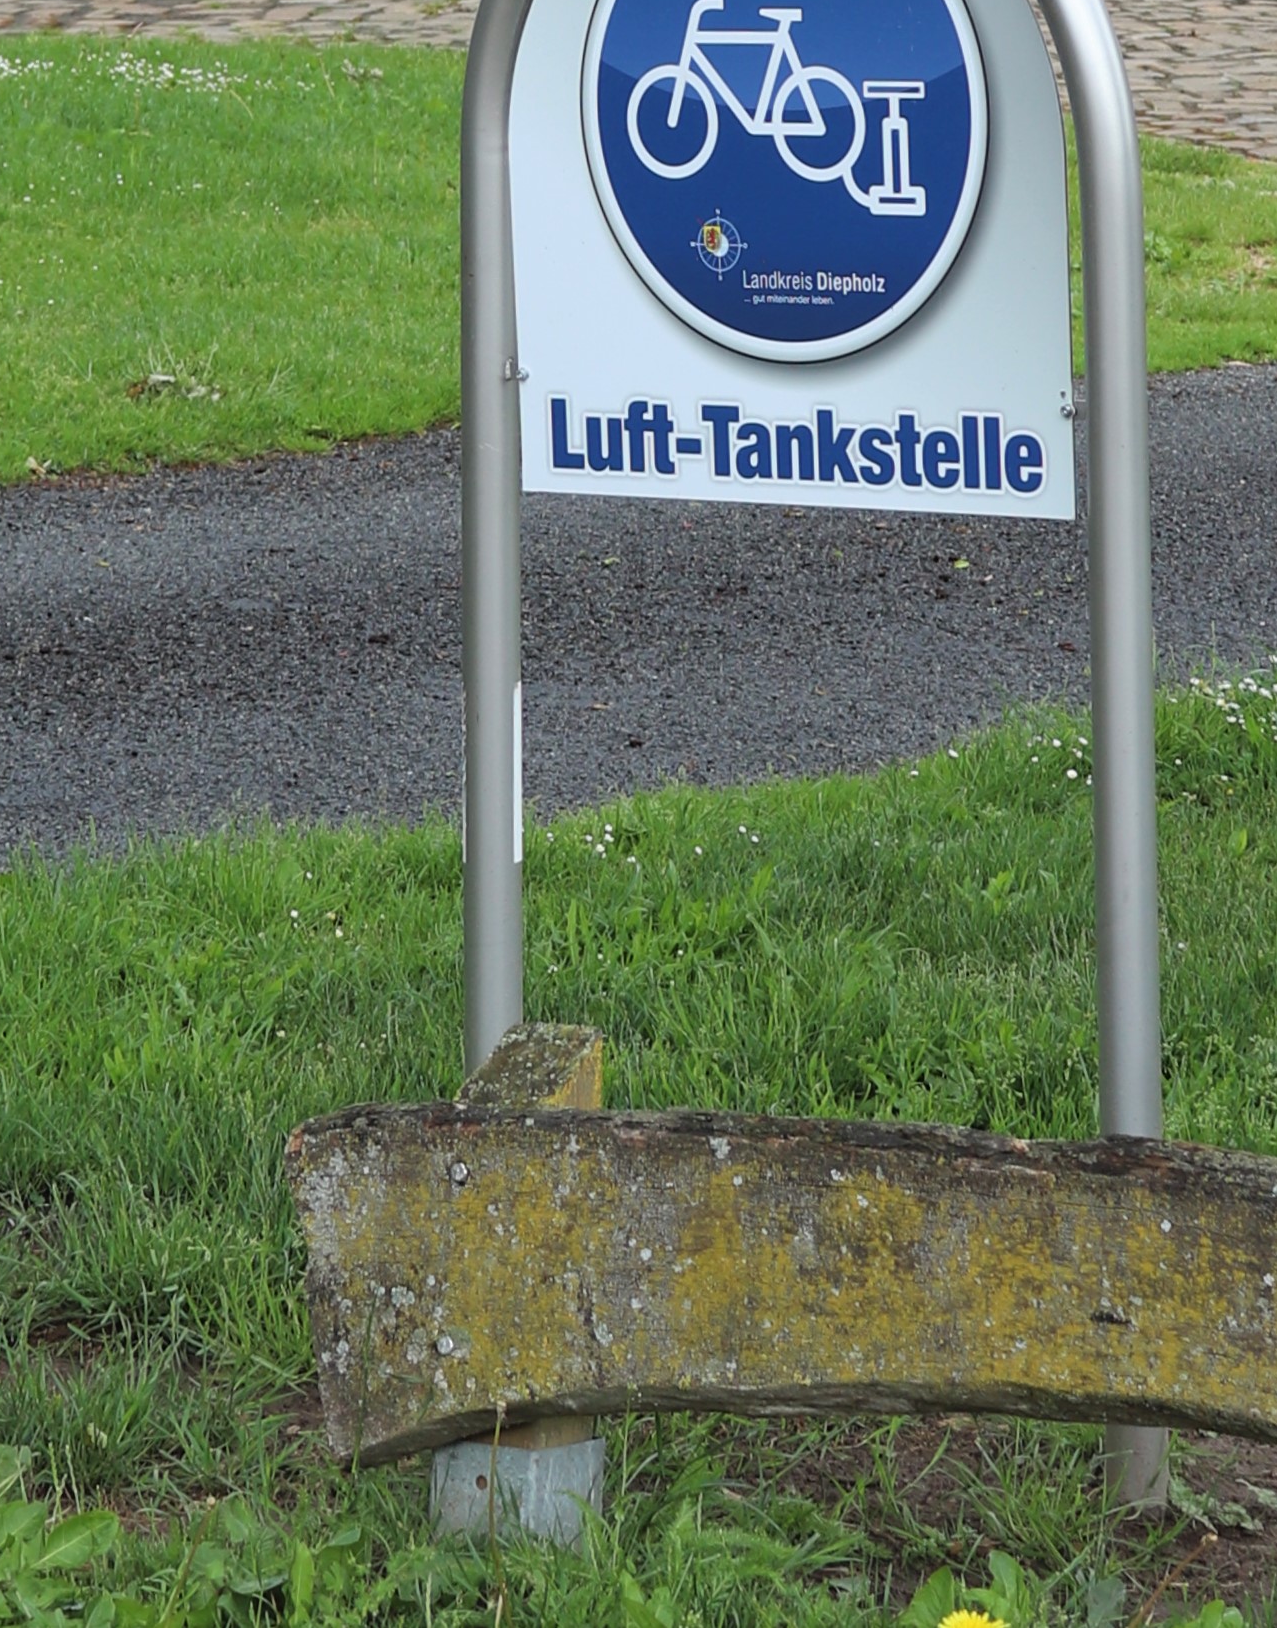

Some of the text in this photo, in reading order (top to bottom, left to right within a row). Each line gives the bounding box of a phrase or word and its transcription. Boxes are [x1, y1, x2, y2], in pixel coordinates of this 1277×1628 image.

[742, 269, 886, 296] Landkreis Diepholz
[549, 397, 1044, 494] Luft-Tankstelle
